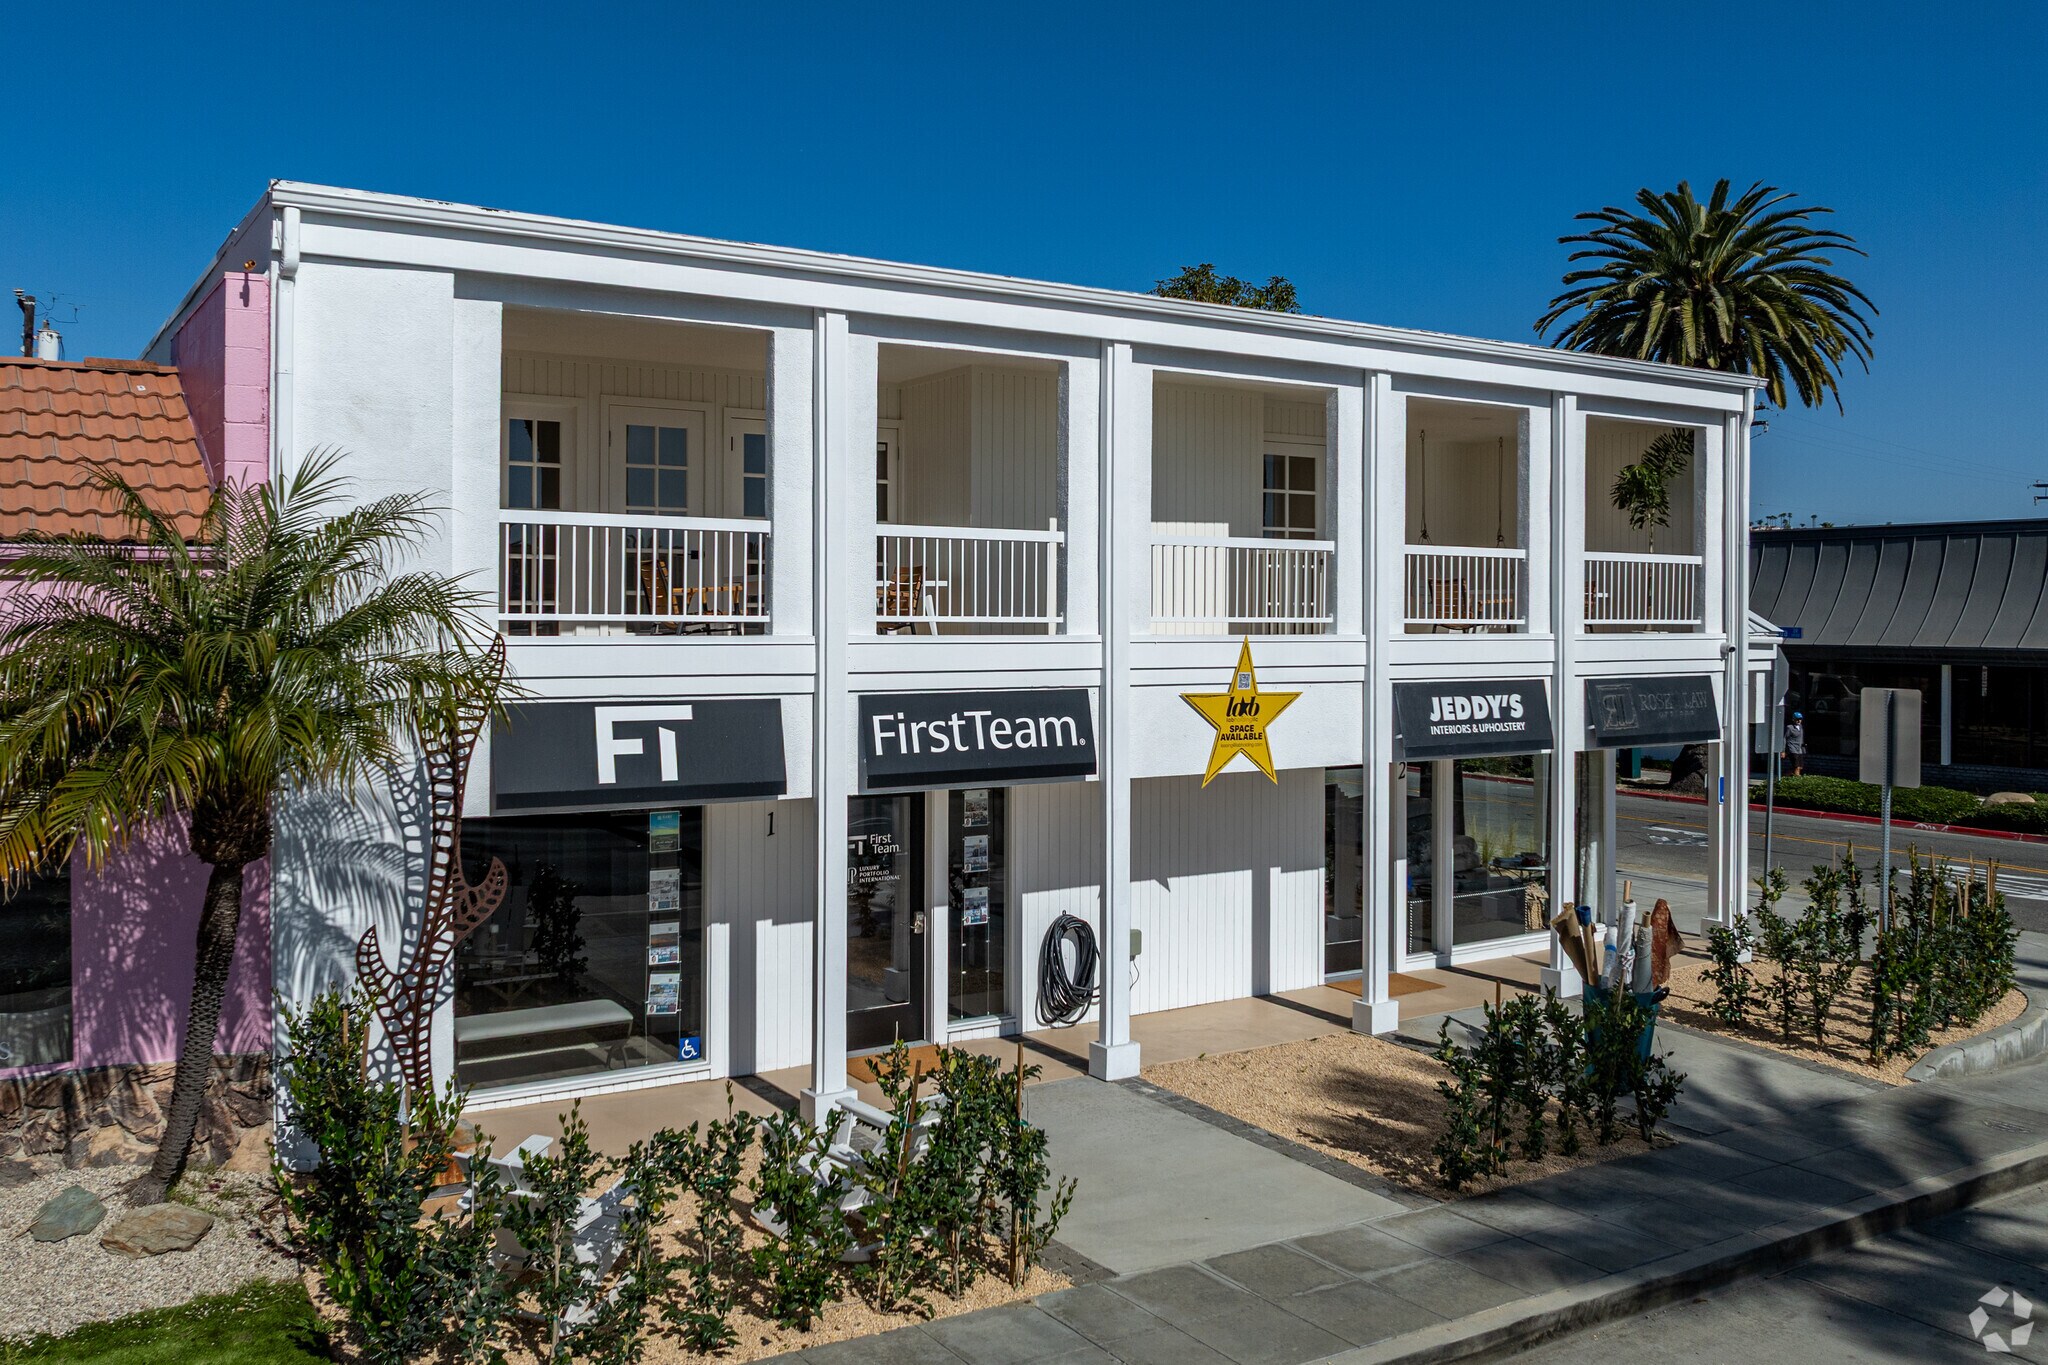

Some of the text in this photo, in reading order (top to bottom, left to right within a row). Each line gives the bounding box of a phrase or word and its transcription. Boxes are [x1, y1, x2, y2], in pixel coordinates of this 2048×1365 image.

[1430, 694, 1524, 721] JEDDY'S
[1229, 724, 1255, 733] SPACE
[1430, 721, 1526, 735] INTERIORS & UPHOLSTERY
[1220, 732, 1263, 741] AVAILABLE
[1398, 761, 1406, 780] 2
[767, 811, 776, 837] 1
[870, 833, 892, 844] First
[872, 843, 900, 854] Team
[859, 864, 880, 872] LUXURY
[859, 869, 890, 878] PORTFOLIO
[859, 875, 901, 883] INTERNATIONAL
